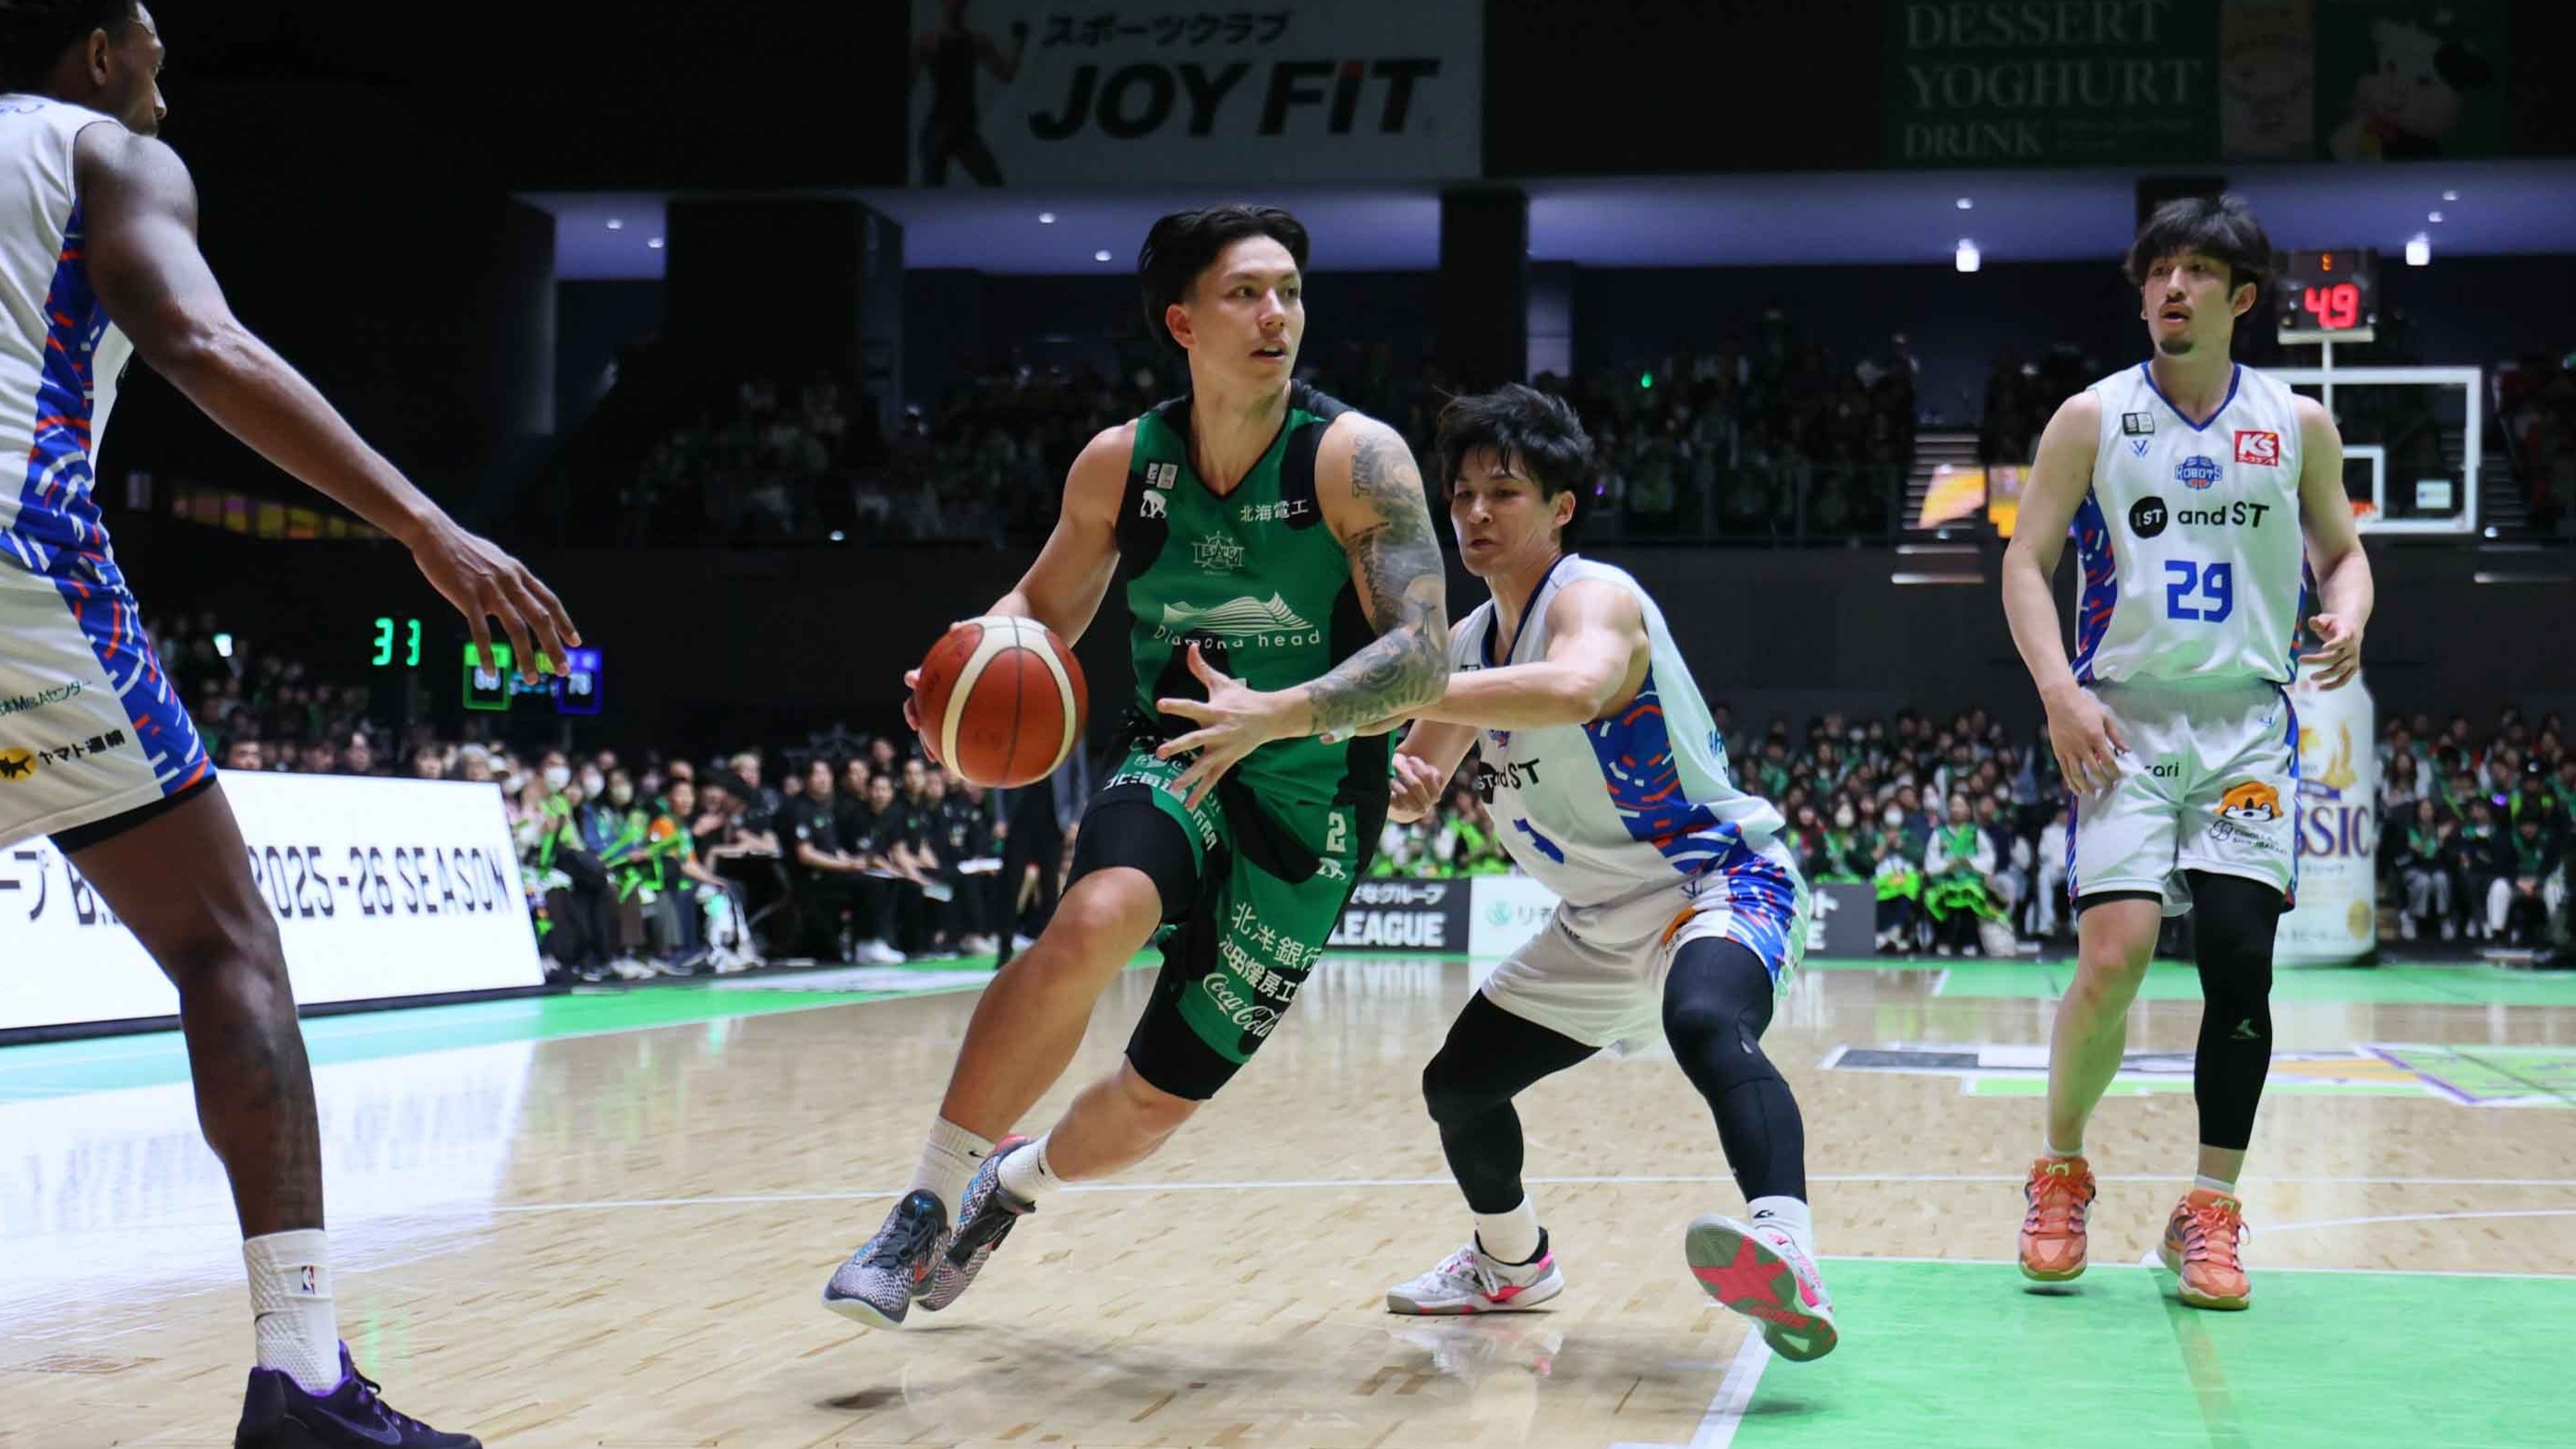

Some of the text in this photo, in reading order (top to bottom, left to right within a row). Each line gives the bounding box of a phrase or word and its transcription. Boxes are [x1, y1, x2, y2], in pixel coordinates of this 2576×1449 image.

[1042, 12, 1291, 48] スポーツクラブ
[1905, 1, 2172, 50] DESSERT
[1903, 56, 2207, 110] YOGHURT
[1905, 120, 2043, 160] DRINK
[2304, 282, 2359, 330] 49
[2175, 465, 2224, 482] ROBOTS
[1240, 499, 1310, 523] 北海電工
[2178, 501, 2270, 528] and ST
[2164, 560, 2233, 623] 29
[1258, 629, 1321, 648] head
[1325, 811, 1347, 853] 2
[394, 846, 513, 915] SEASON
[1230, 901, 1323, 972] 北洋銀行
